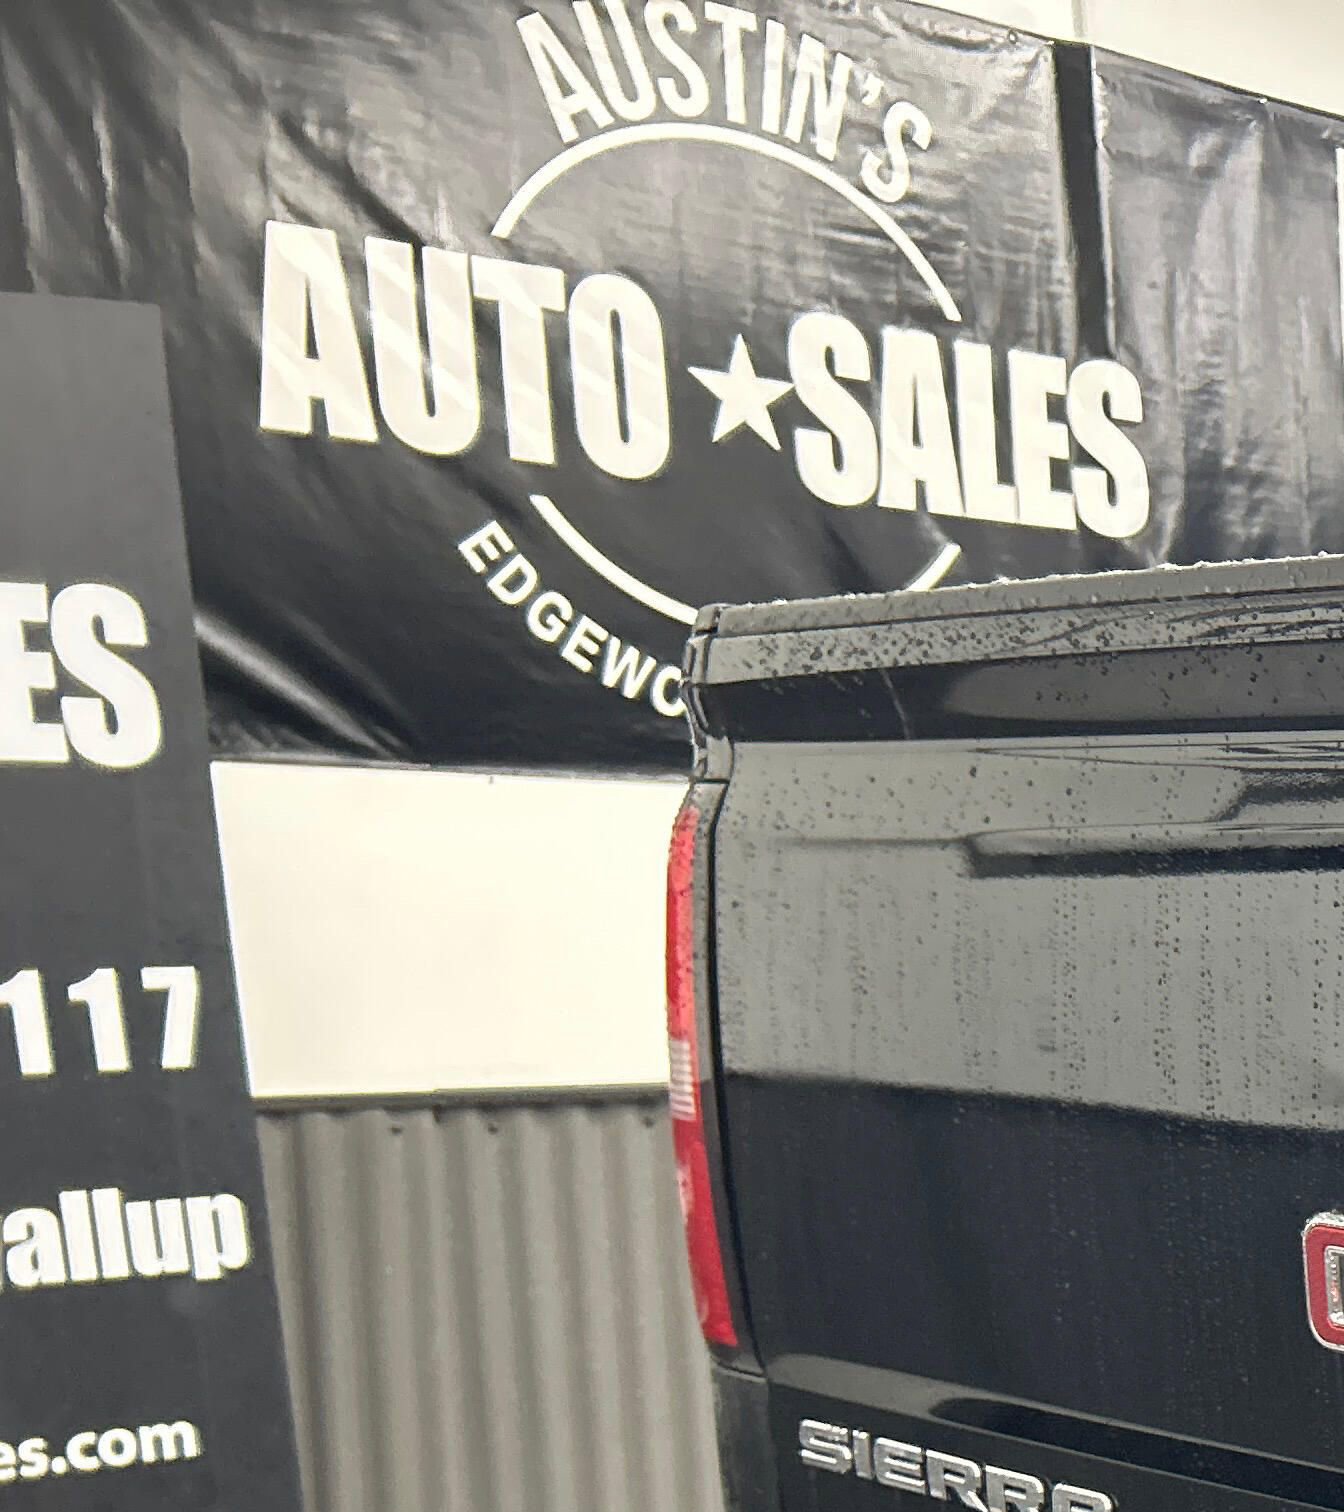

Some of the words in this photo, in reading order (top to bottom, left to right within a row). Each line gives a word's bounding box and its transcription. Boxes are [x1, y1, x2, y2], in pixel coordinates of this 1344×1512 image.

[516, 0, 933, 203] AUSTIN'S
[259, 219, 672, 480] AUTO
[788, 310, 1150, 540] SALES
[0, 1187, 248, 1291] allup
